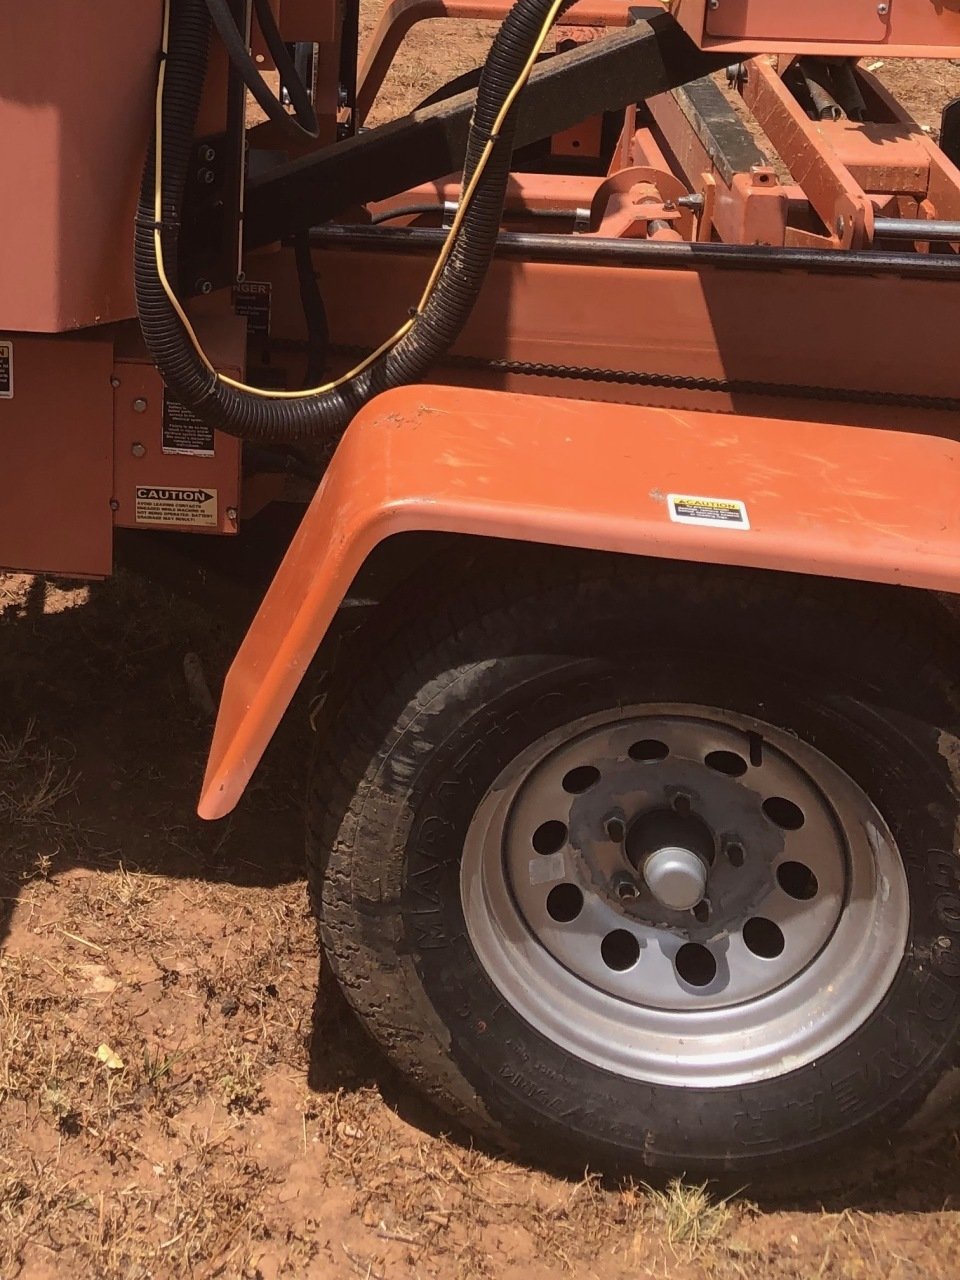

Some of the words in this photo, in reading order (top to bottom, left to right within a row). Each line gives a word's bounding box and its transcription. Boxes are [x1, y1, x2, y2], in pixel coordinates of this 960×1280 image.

[232, 284, 266, 294] NGER
[138, 489, 205, 501] CAUTION
[686, 499, 735, 508] CAUTION
